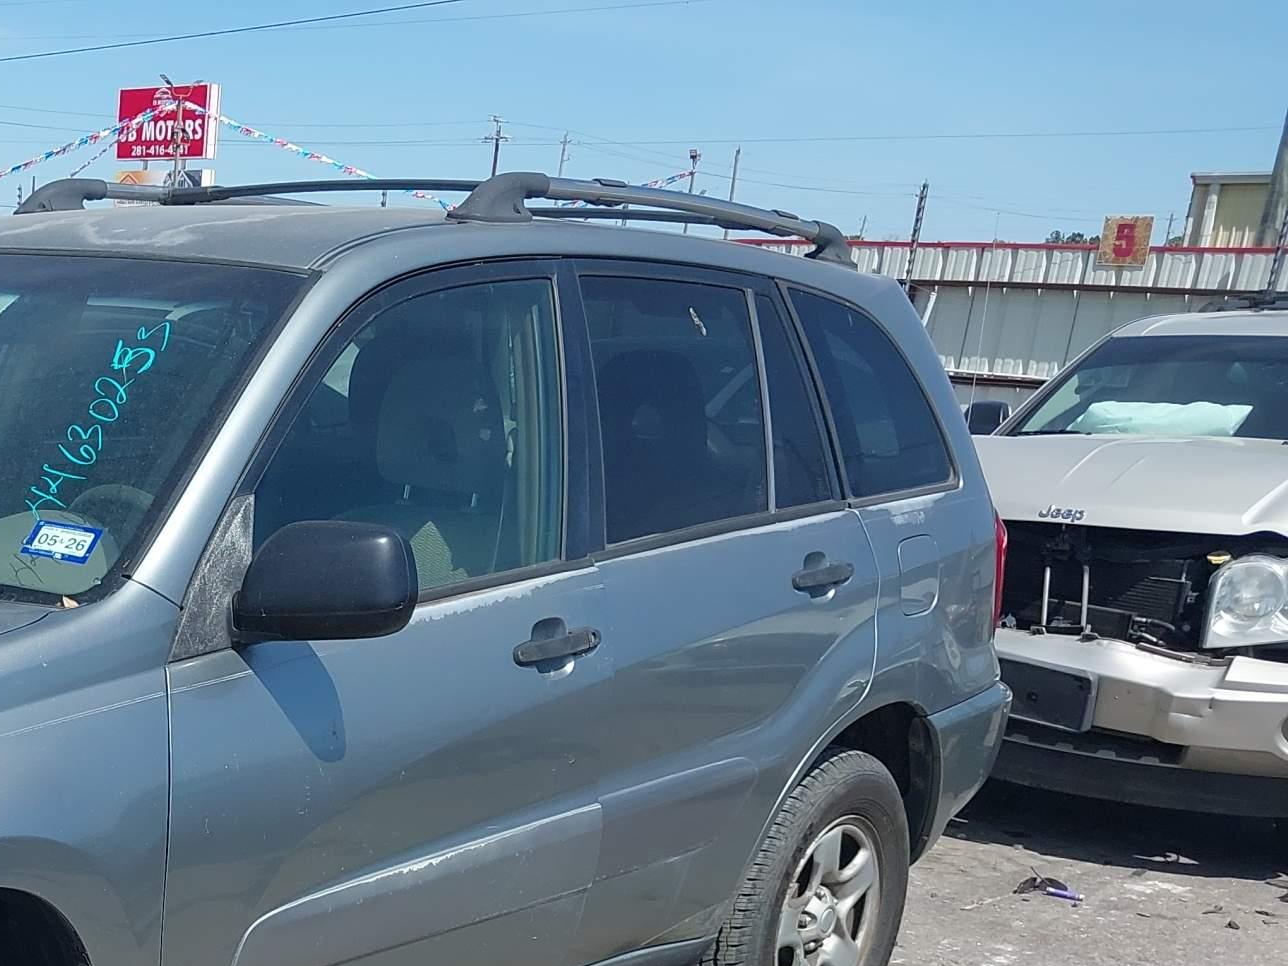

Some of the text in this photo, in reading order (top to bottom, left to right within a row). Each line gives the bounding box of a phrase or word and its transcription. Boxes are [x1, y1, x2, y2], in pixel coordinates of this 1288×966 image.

[1113, 223, 1136, 257] 5
[1038, 504, 1085, 522] Jeep
[38, 533, 88, 551] 05 26
